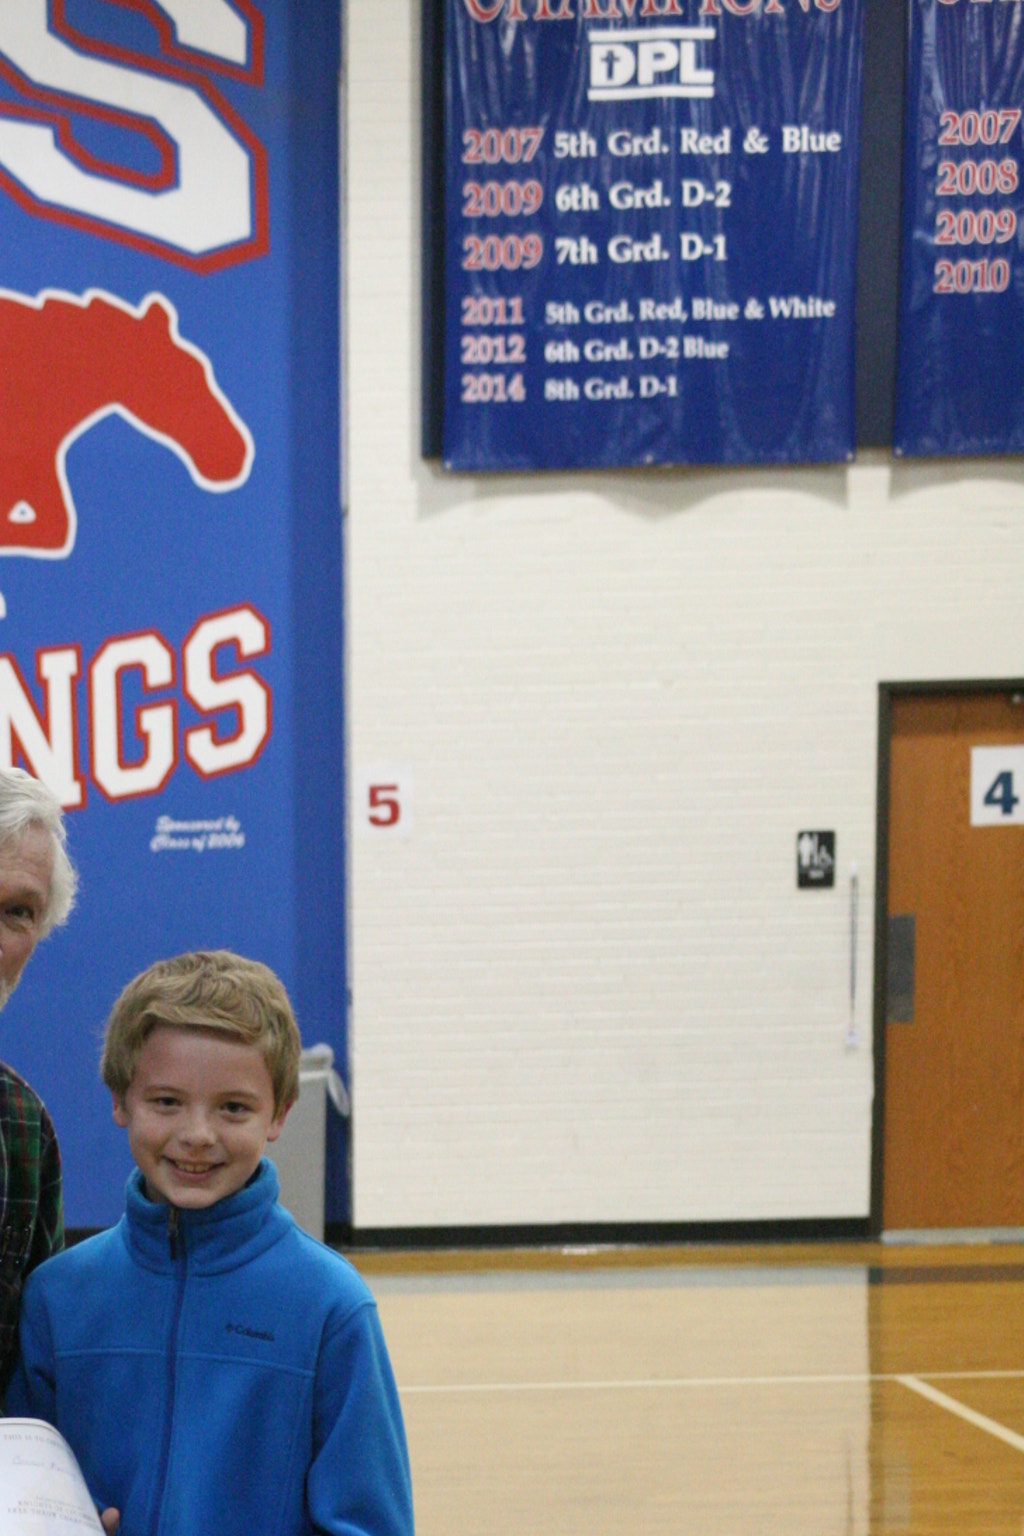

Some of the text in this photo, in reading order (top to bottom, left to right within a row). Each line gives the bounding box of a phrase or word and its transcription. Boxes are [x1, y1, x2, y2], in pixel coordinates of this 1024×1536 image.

[590, 41, 716, 88] DPL
[461, 126, 842, 164] 2007 5th Grd. Red & Blue
[938, 108, 1022, 146] 2007
[935, 158, 1019, 196] 2008
[461, 180, 732, 217] 2009 6th Grd. D-2
[934, 208, 1017, 246] 2009
[461, 234, 728, 271] 2009 7th Grd. D-1
[933, 258, 1011, 294] 2010
[461, 297, 525, 326] 2011
[583, 299, 634, 324] Grd.
[691, 297, 739, 321] Blue
[744, 298, 764, 320] &
[769, 295, 836, 319] White
[461, 334, 526, 364] 2012
[583, 338, 634, 363] Grd.
[639, 336, 679, 360] D-2
[683, 335, 729, 360] Blue
[461, 373, 526, 402] 2014
[583, 376, 634, 400] Grd.
[639, 375, 677, 399] D-1
[368, 784, 400, 828] 5
[983, 769, 1019, 816] 4
